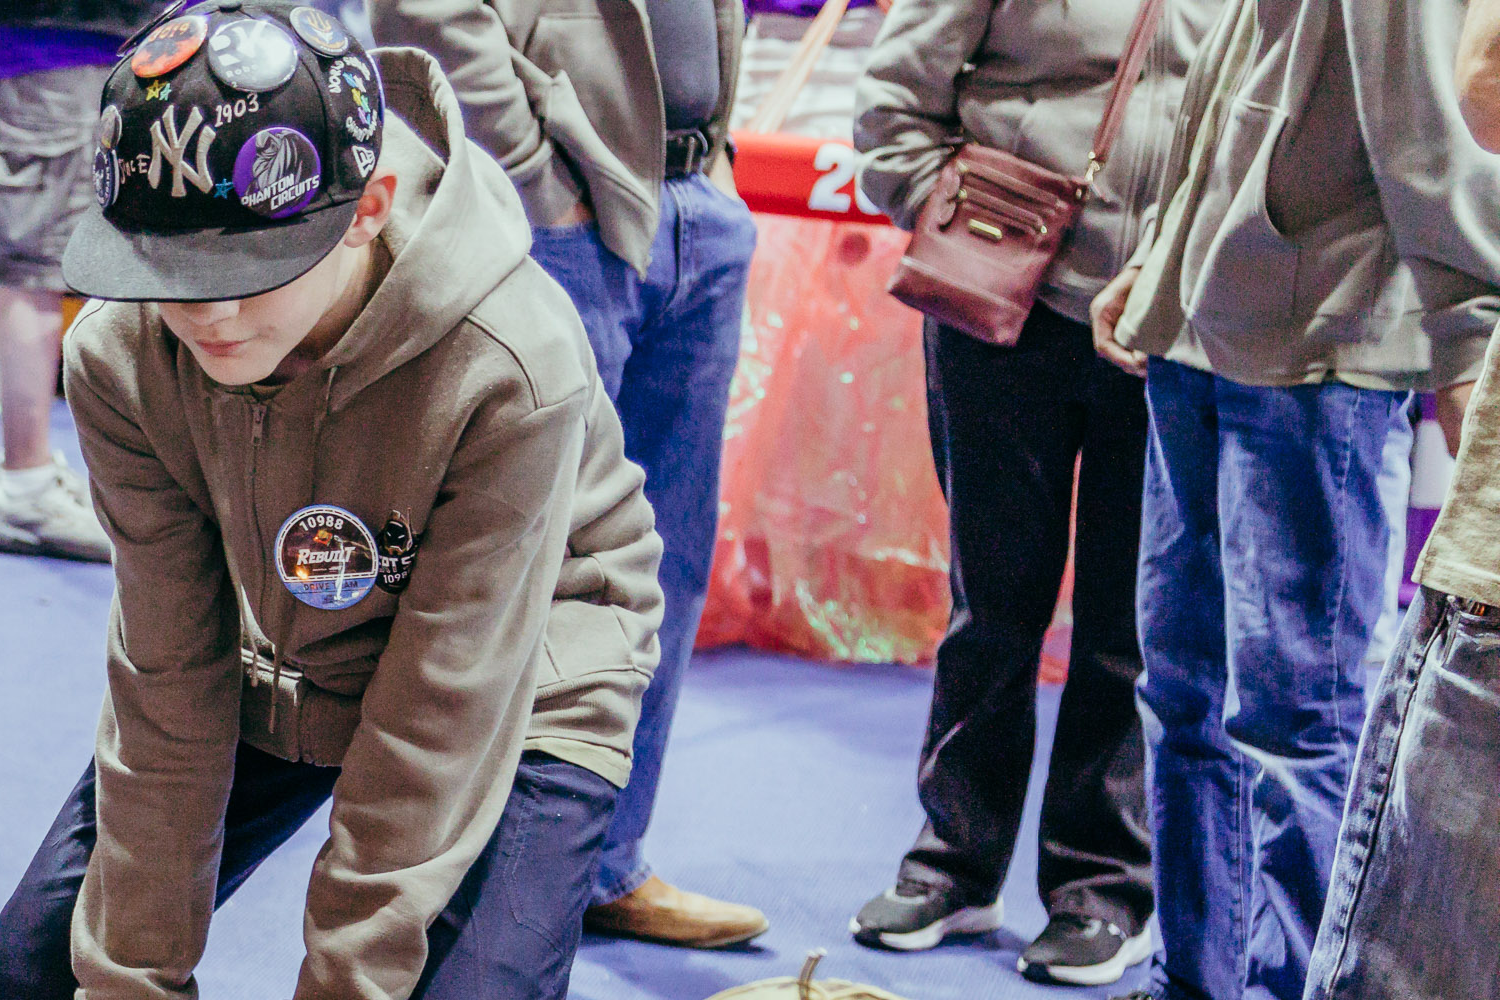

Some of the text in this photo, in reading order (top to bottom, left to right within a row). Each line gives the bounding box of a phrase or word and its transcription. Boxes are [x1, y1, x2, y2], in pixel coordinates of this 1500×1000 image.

[215, 92, 260, 128] 1903
[148, 104, 217, 198] NY
[270, 174, 320, 211] CIRCUITS
[299, 514, 345, 532] 10988
[303, 580, 358, 591] DRIVE TAM
